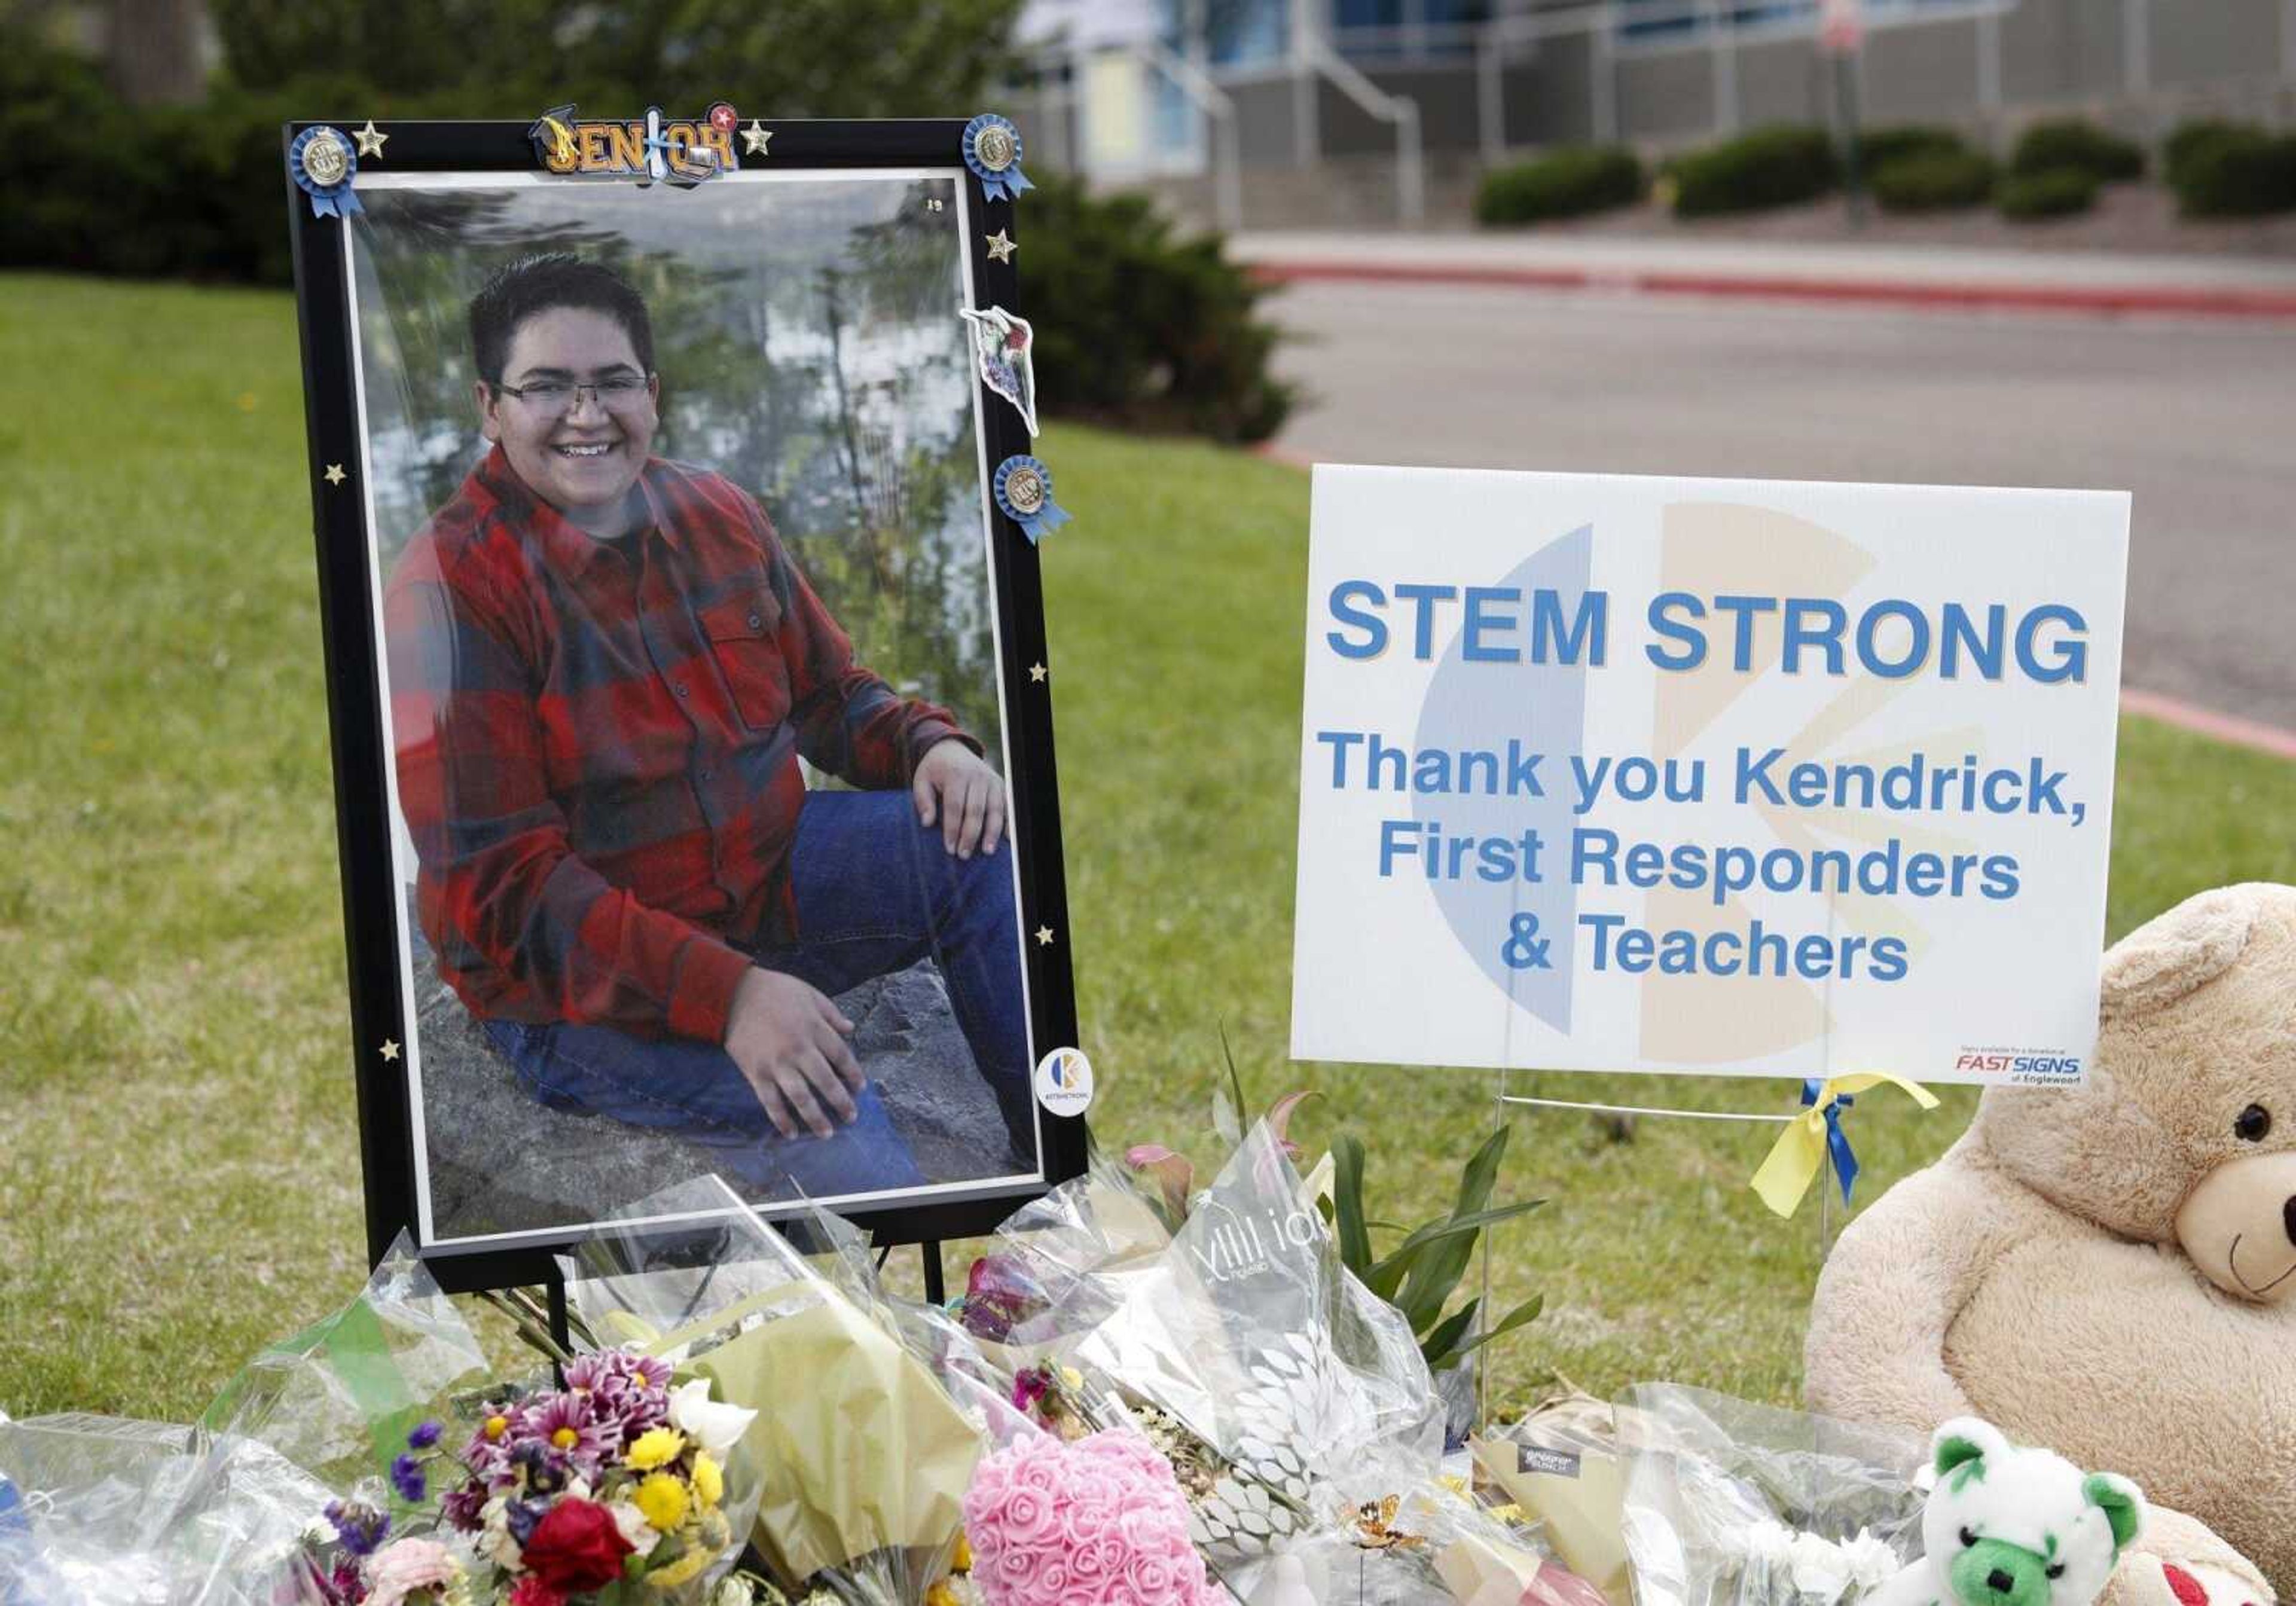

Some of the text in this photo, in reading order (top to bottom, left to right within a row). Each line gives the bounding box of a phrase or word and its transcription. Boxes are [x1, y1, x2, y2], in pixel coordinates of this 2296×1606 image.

[1326, 579, 2089, 684] STEM STRONG
[1317, 730, 2086, 824] Thank you Kendrick,
[1379, 819, 2022, 904] First Responders
[1500, 910, 1908, 982] & Teachers
[1956, 1055, 2080, 1074] FASTSIGNS
[2023, 1076, 2081, 1085] Englewood
